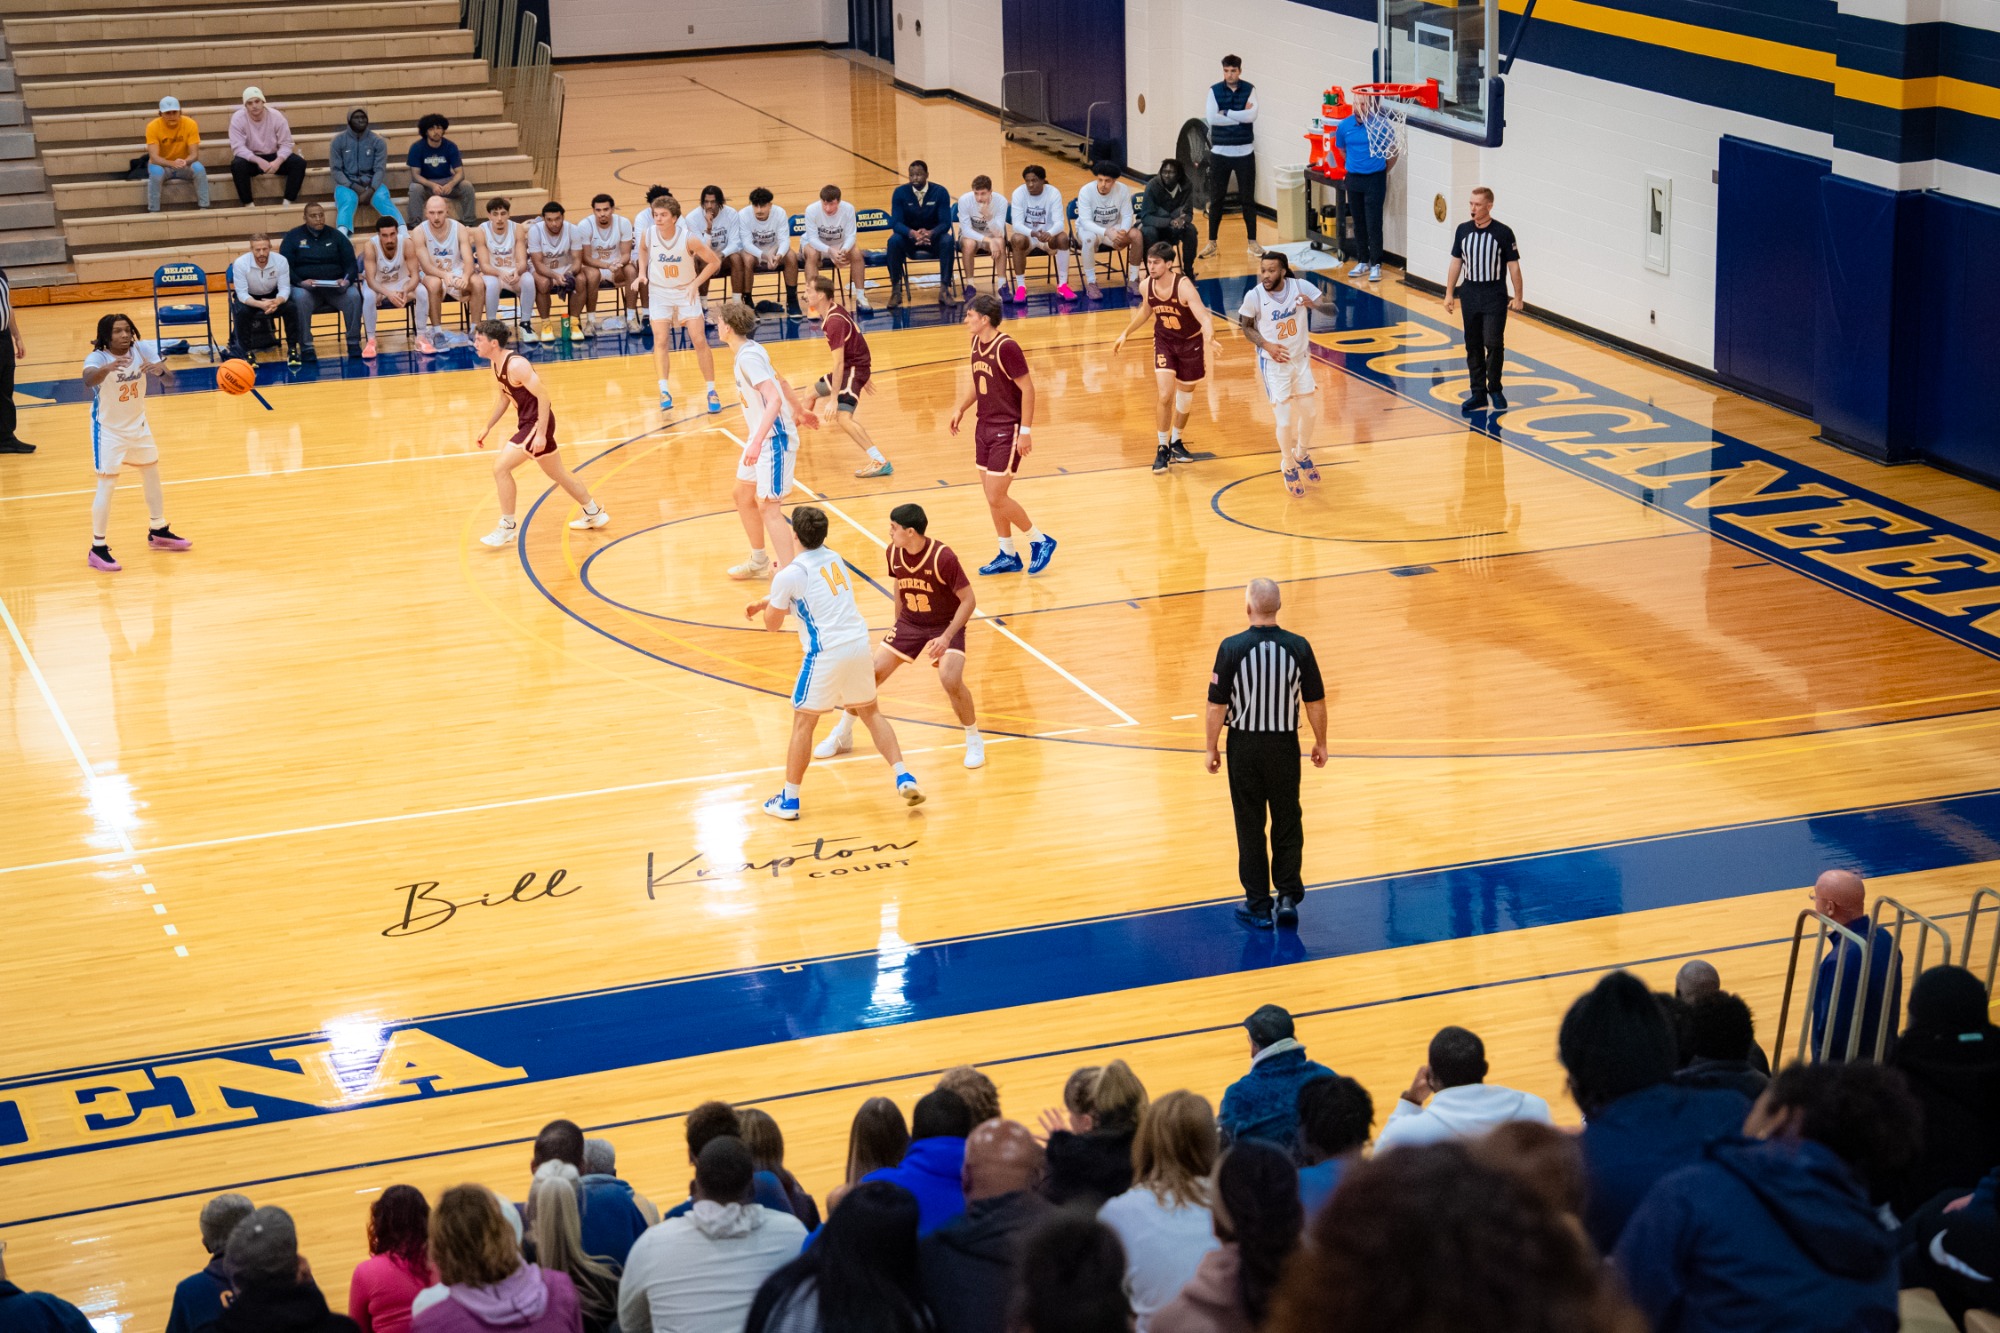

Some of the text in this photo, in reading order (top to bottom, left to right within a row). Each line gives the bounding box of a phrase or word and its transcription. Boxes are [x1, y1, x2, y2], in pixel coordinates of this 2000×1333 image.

[856, 219, 888, 228] COLLEGE
[858, 212, 884, 220] BELOIT
[161, 274, 198, 282] COLLEGE
[163, 266, 195, 275] BELOIT
[663, 264, 679, 279] 10
[1276, 318, 1298, 341] 20
[118, 382, 139, 402] 24
[979, 375, 988, 395] 0
[820, 562, 849, 596] 14
[905, 592, 932, 612] 32
[808, 858, 911, 879] COURT
[381, 868, 583, 938] Bill
